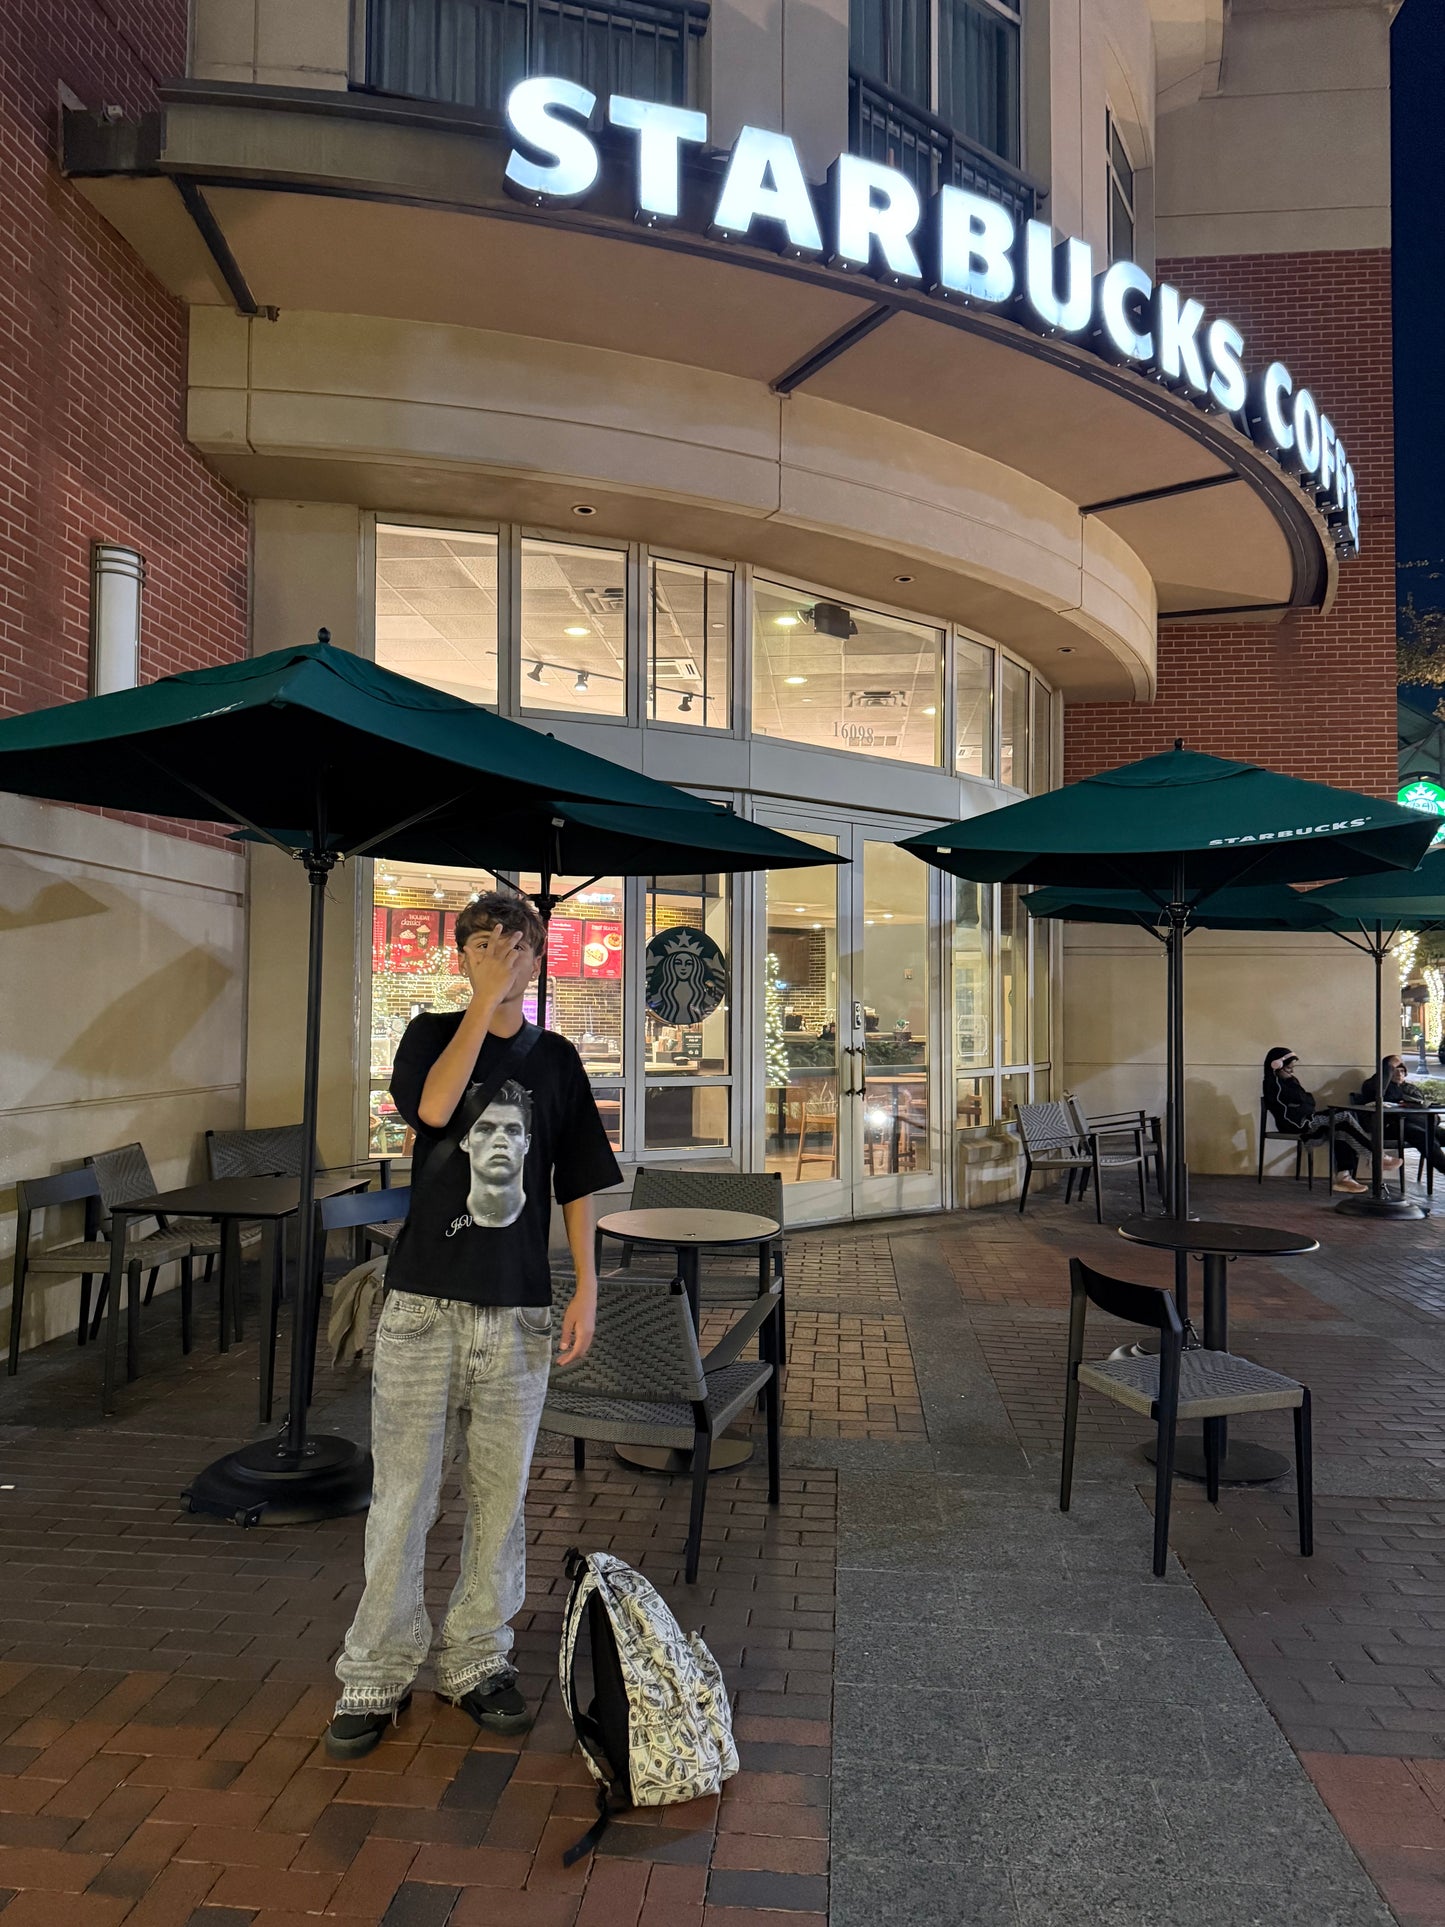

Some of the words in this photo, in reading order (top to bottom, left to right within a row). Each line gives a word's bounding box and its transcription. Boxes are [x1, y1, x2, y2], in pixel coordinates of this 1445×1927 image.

[505, 76, 1247, 412] STARBUCKS
[1265, 361, 1359, 553] COFFE
[834, 722, 874, 744] 16098
[1208, 817, 1368, 846] STARBUCKS
